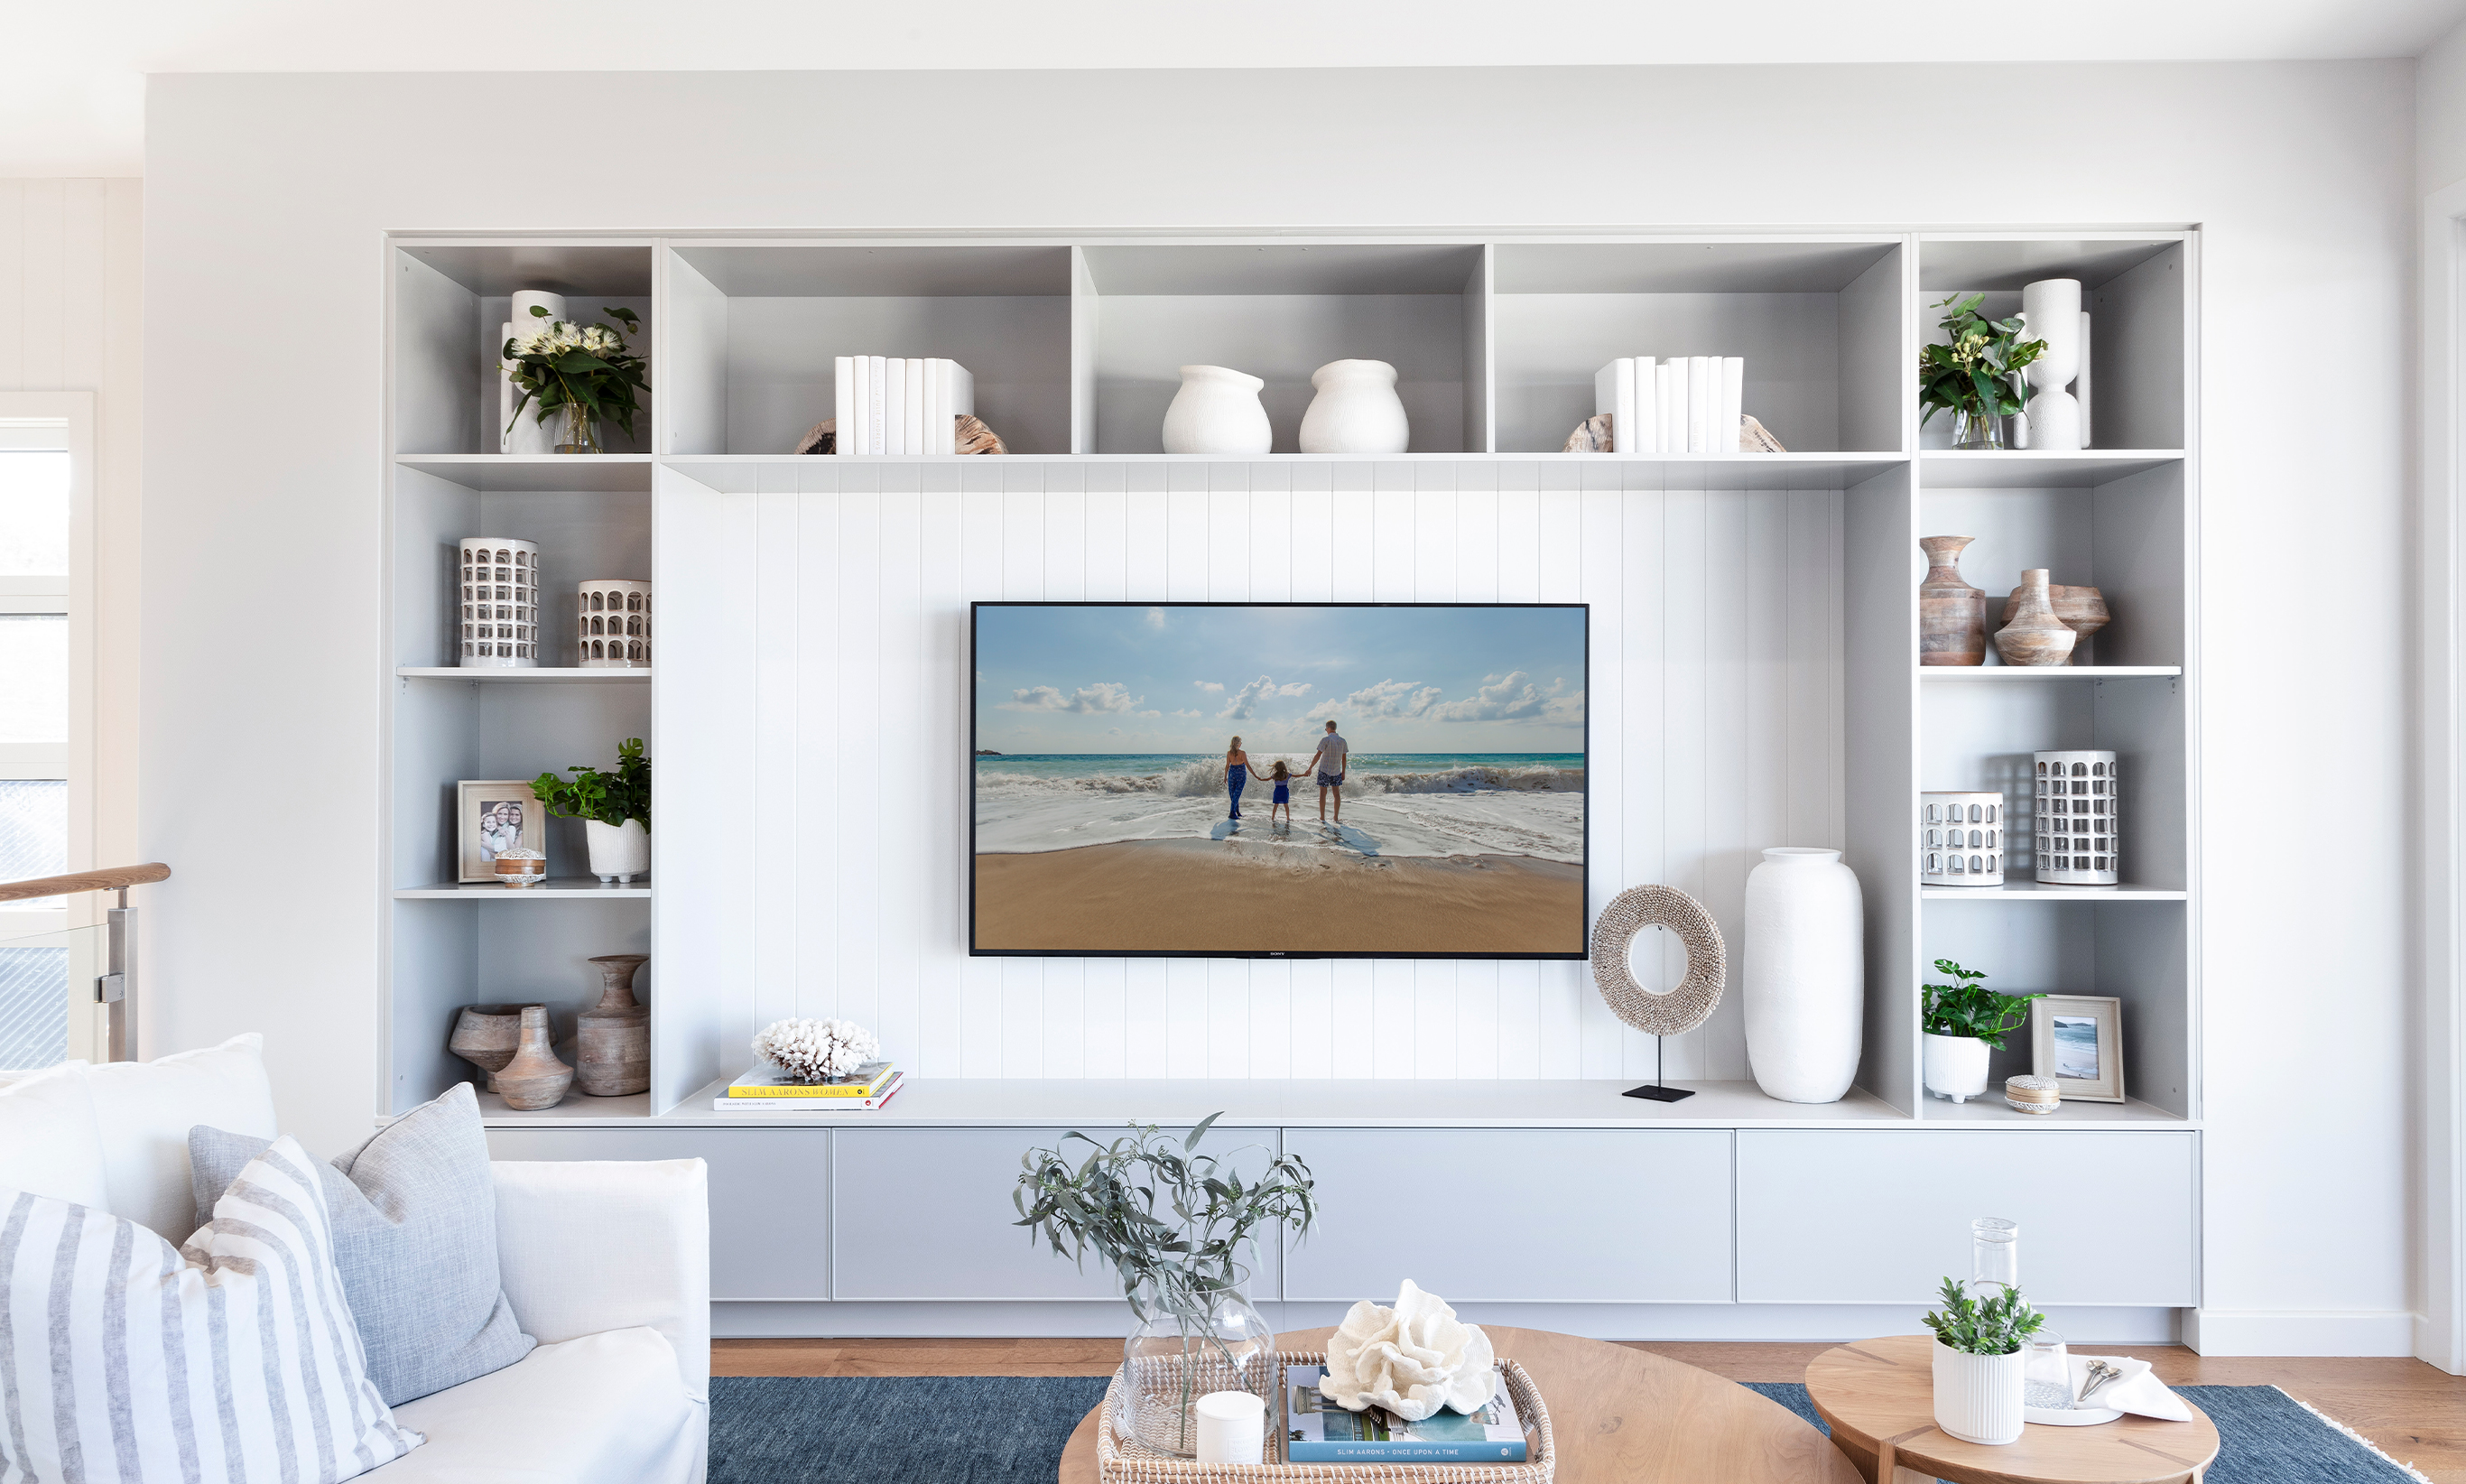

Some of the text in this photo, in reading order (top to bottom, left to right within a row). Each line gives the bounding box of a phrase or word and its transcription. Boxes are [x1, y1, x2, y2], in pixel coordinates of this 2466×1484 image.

[741, 1088, 849, 1096] SLIM AARONS WOMEN
